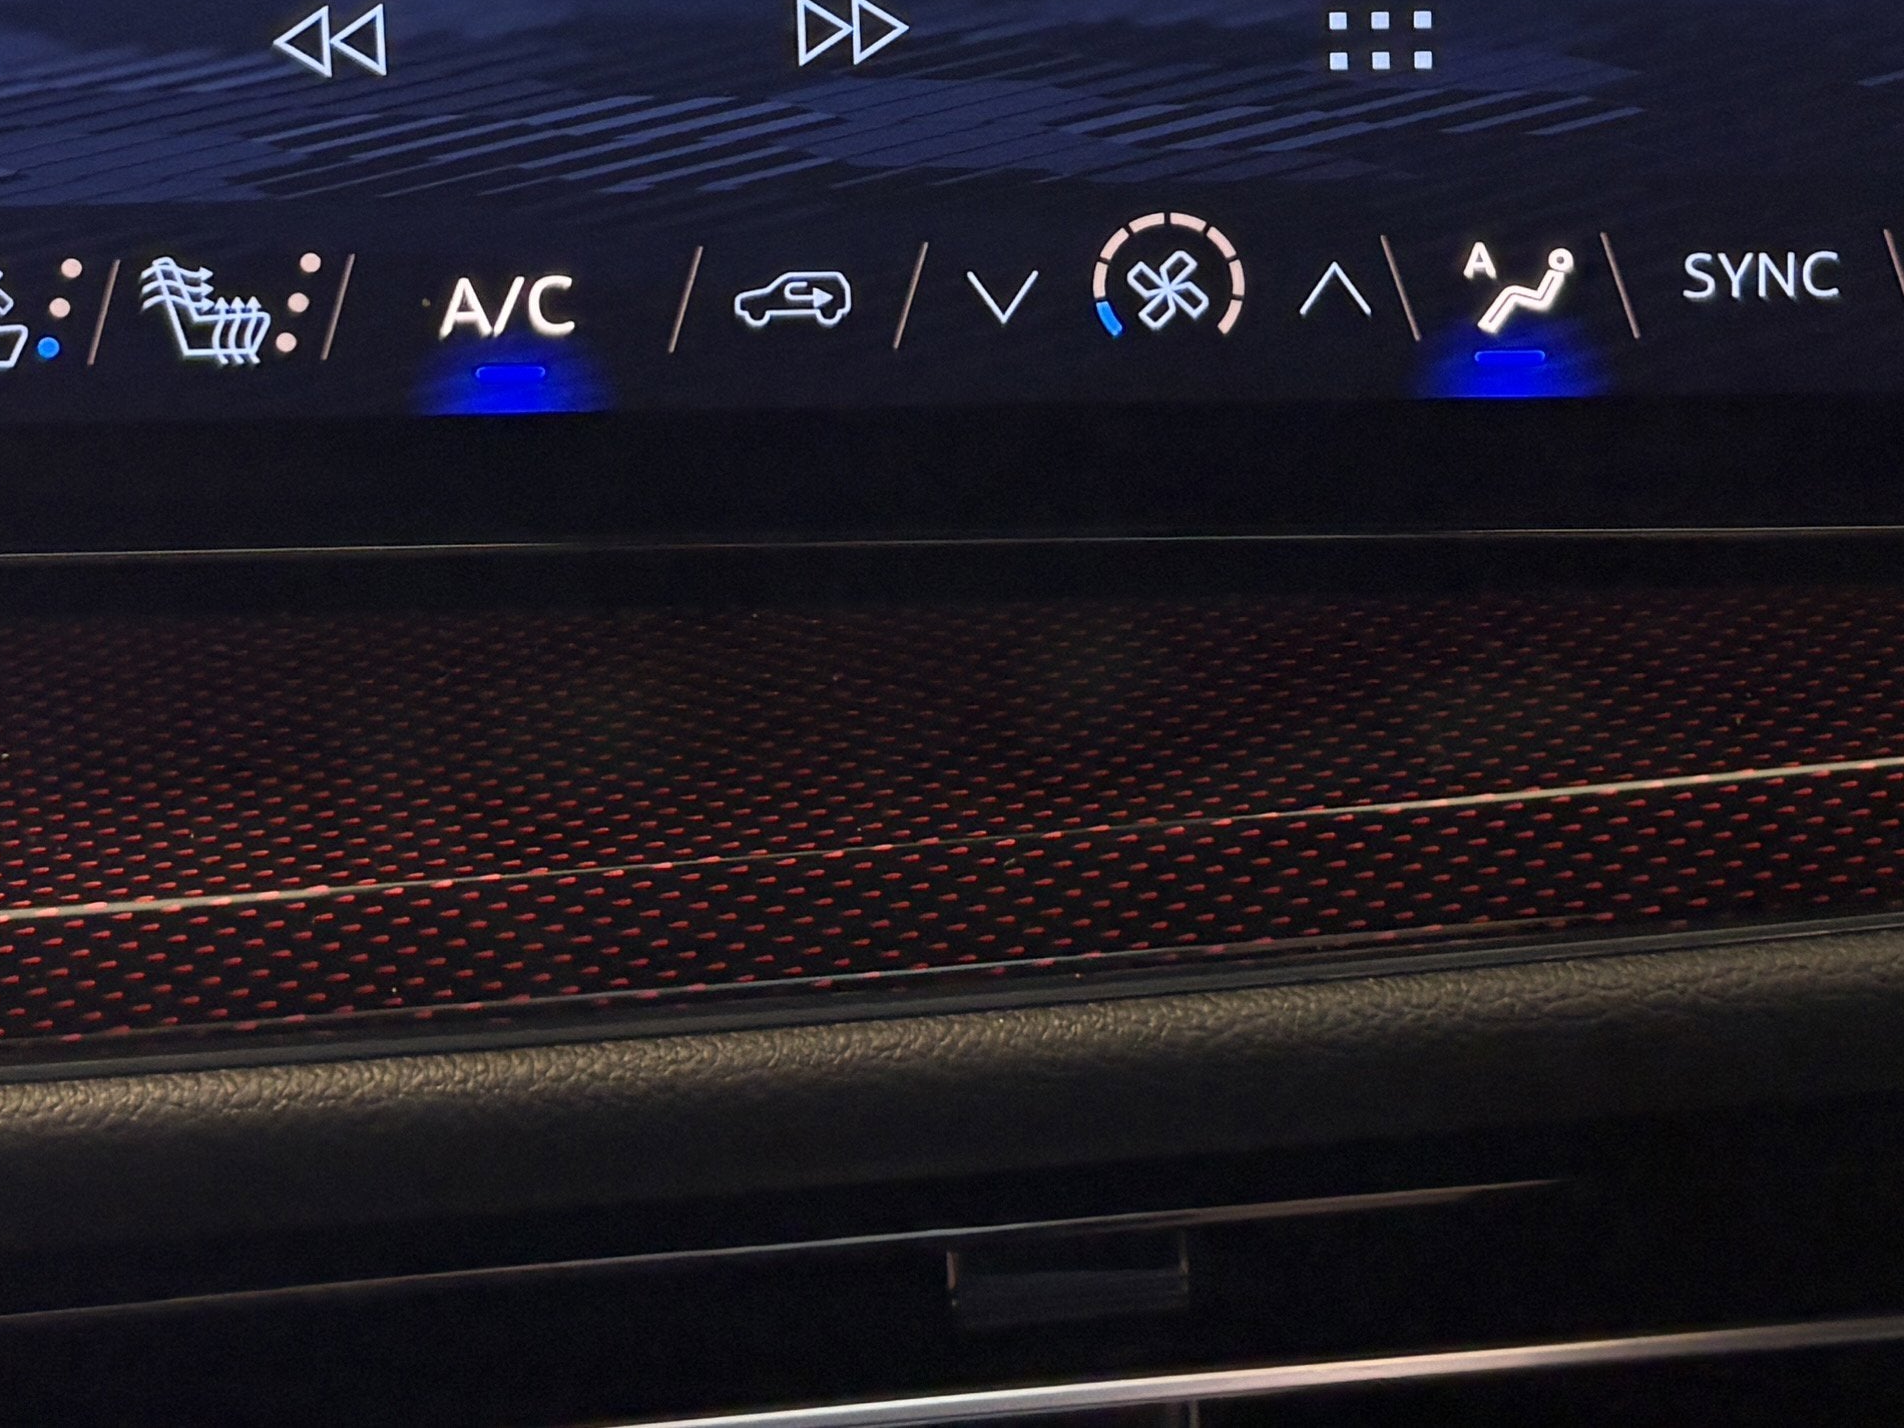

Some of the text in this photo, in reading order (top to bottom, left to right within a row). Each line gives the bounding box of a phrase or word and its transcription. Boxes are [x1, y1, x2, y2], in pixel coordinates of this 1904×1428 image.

[1463, 241, 1497, 279] A
[1682, 250, 1840, 300] SYNC
[439, 274, 576, 338] A/C
